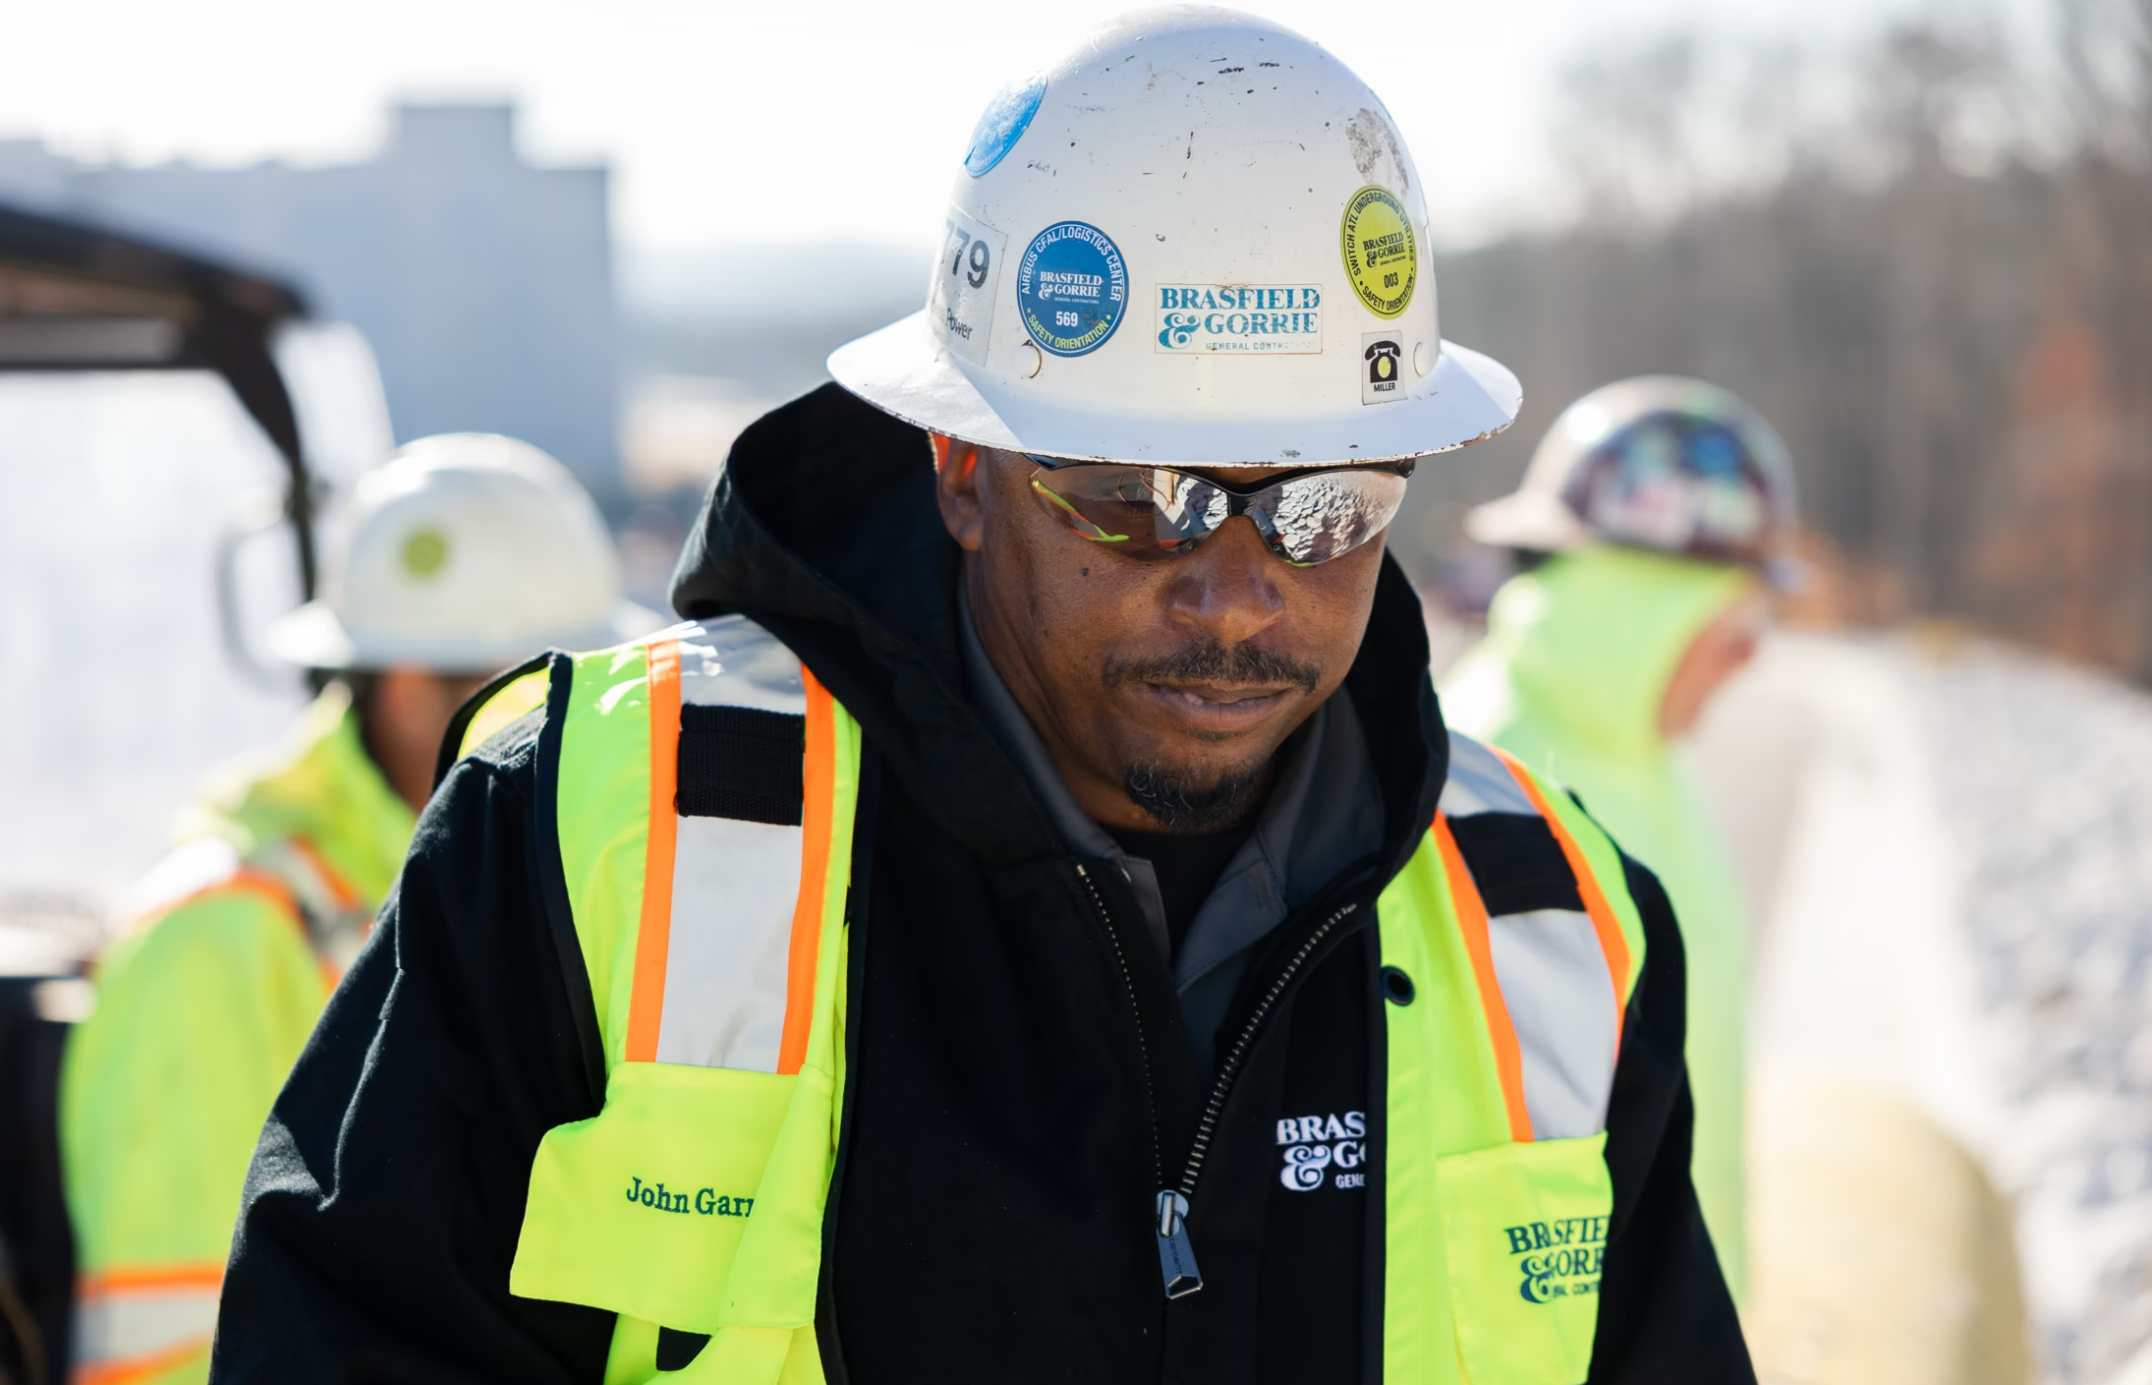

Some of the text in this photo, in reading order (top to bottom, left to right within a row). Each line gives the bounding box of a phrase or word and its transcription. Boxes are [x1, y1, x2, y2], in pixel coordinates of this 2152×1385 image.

[1347, 192, 1414, 276] SWITCH ATL UNDERGROUND UTILITIES
[1362, 232, 1404, 251] BRASFIELD
[1022, 227, 1123, 301] AIRBUS CFAL/LOGISTICS CENTER
[1366, 251, 1378, 268] &
[1378, 243, 1405, 258] GORRIE
[1038, 283, 1101, 300] & GORRIE
[1040, 271, 1102, 286] BRASFIELD
[1362, 272, 1414, 311] SAFETY ORIENTATION
[1384, 272, 1399, 288] 003
[1159, 288, 1321, 310] BRASFIELD
[1029, 315, 1109, 349] SAFETY ORIENTATION
[1056, 311, 1078, 327] 569
[1158, 312, 1319, 350] & GORRIE
[1205, 342, 1250, 350] GENERAL
[1373, 382, 1396, 392] MILLER
[1276, 1110, 1366, 1145] BRAS
[1280, 1145, 1332, 1192] &
[626, 1176, 690, 1214] John
[1520, 1255, 1553, 1304] &
